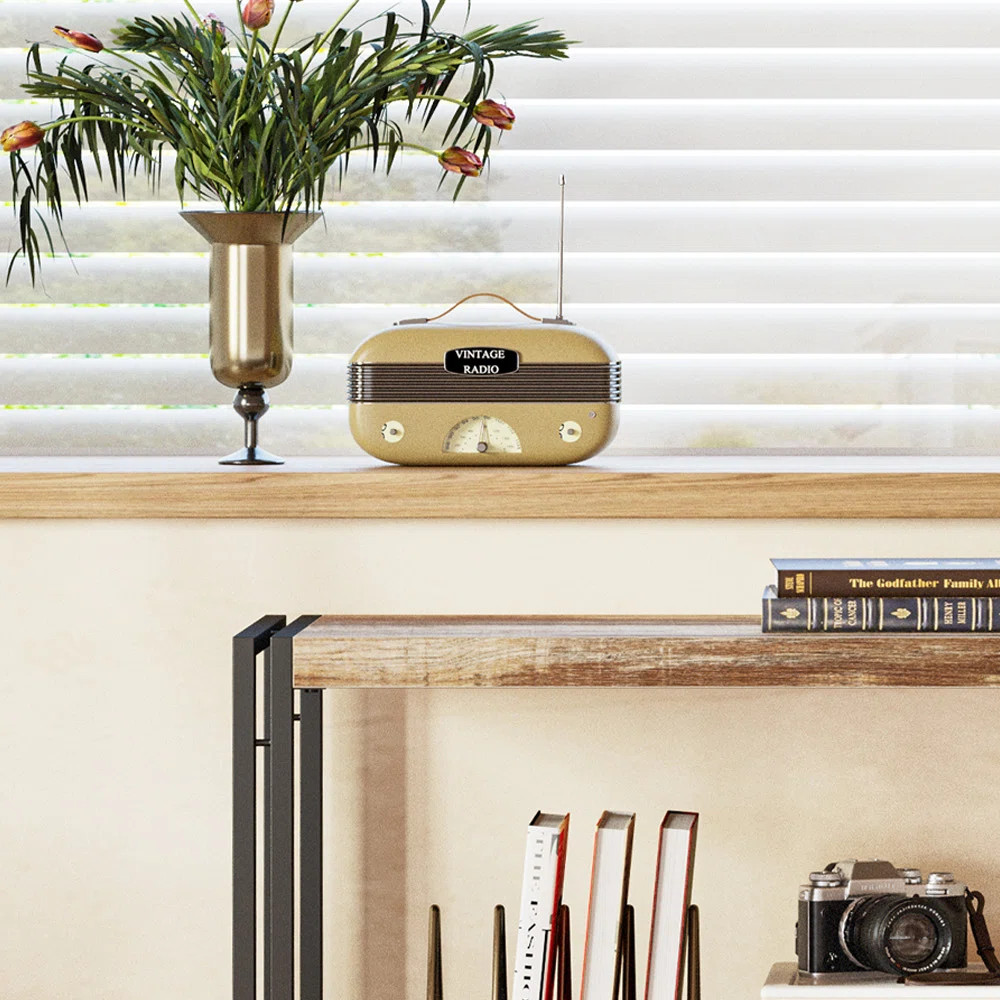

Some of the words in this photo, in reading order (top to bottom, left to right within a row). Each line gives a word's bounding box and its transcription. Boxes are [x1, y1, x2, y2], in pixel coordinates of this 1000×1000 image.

[455, 349, 506, 359] VINTAGE
[463, 364, 500, 374] RADIO
[849, 578, 874, 588] The
[876, 578, 940, 588] Godfather
[943, 578, 985, 590] Family
[943, 601, 953, 625] HENRY
